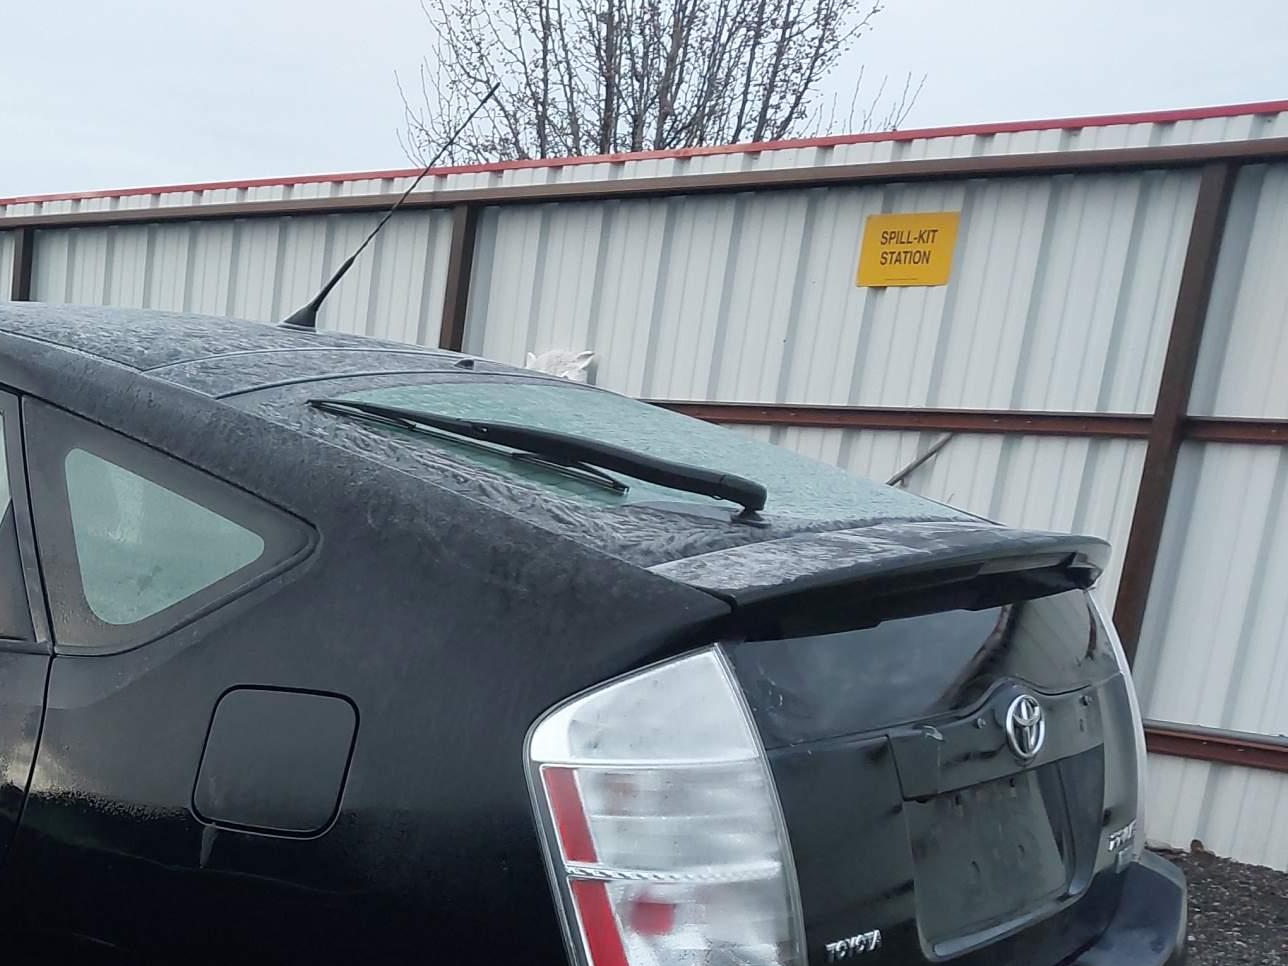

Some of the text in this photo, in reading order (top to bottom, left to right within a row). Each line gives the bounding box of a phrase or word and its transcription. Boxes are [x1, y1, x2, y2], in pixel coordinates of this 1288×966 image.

[880, 229, 939, 245] SPILL-KIT
[880, 250, 931, 266] STATION
[825, 929, 882, 963] TOYOTA
